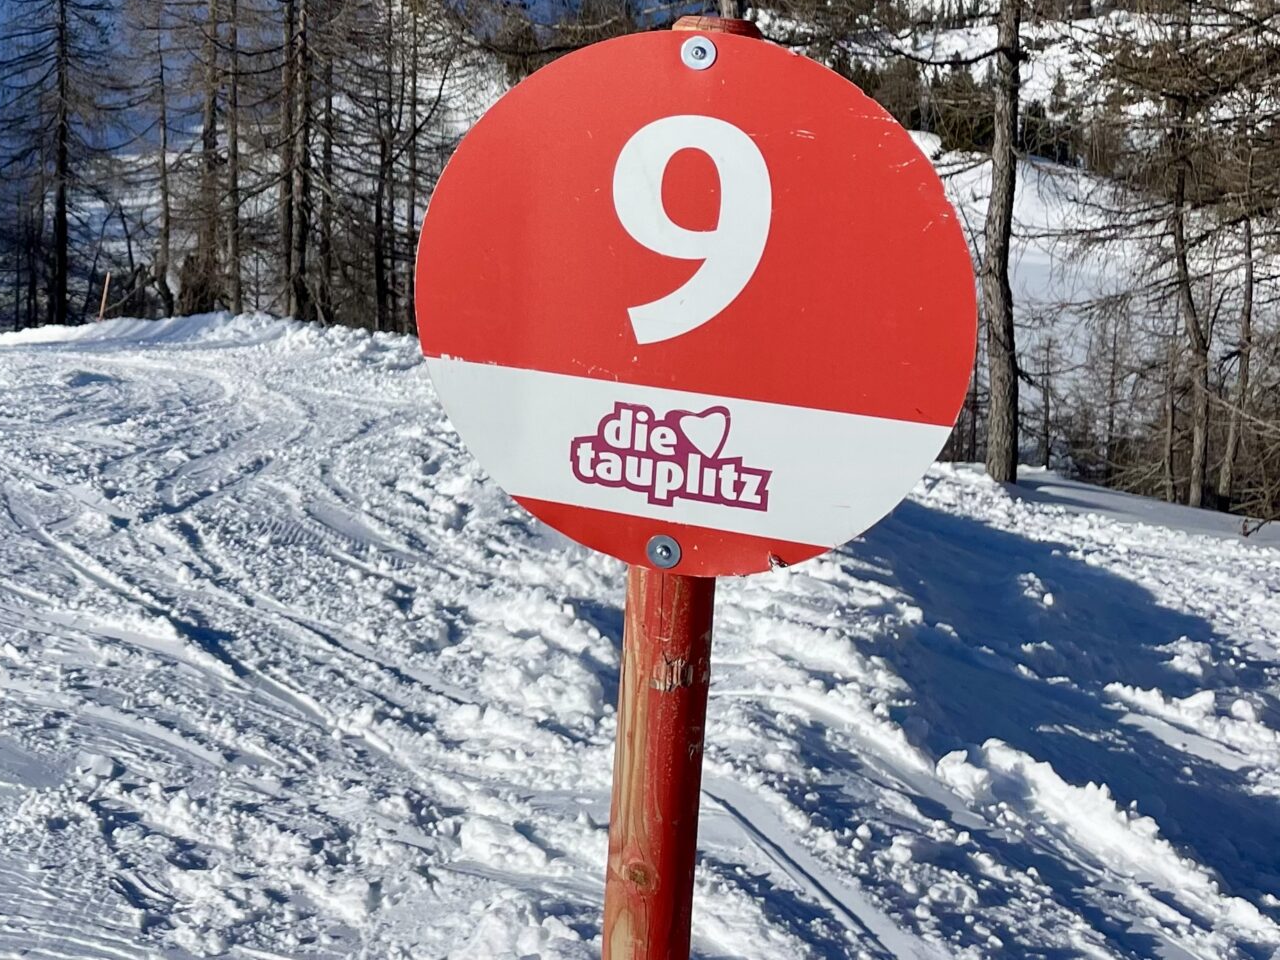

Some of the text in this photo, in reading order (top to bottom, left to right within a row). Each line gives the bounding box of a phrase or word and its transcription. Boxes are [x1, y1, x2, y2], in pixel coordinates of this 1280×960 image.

[612, 114, 772, 345] 9
[603, 408, 678, 456] die
[576, 442, 763, 504] tauplitz
